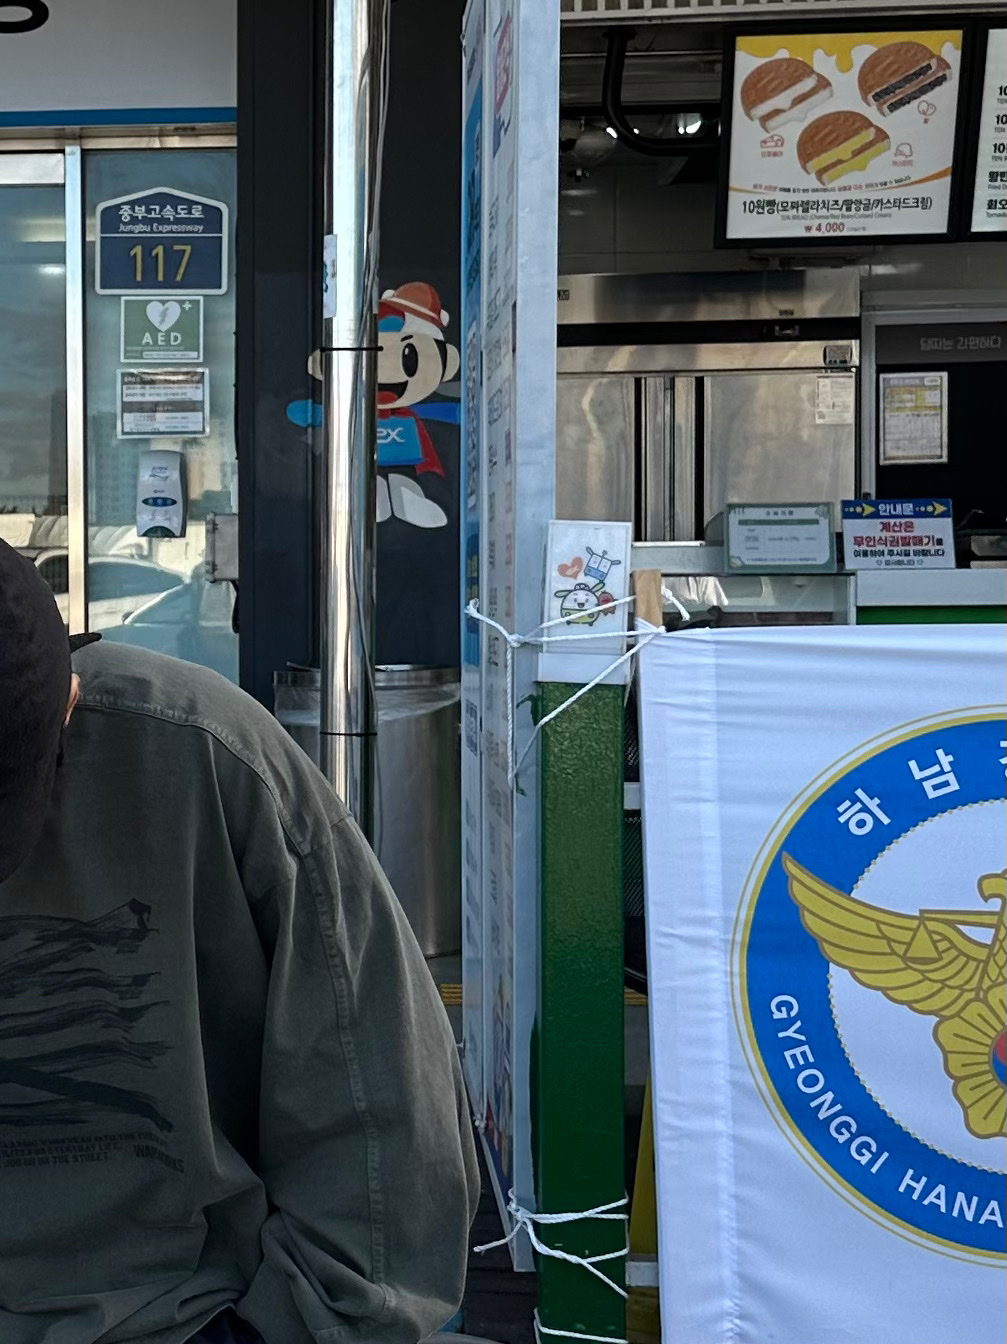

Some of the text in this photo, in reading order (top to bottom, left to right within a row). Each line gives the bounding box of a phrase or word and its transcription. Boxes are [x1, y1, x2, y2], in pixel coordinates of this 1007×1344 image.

[119, 205, 205, 222] 중부고속도로
[119, 223, 204, 234] Jungbu Expressway
[814, 222, 845, 234] 4,000
[129, 245, 192, 282] 117
[142, 332, 182, 346] AED
[878, 503, 914, 516] 안내문
[879, 521, 914, 533] 계산은
[913, 549, 945, 558] 바랍니다
[769, 994, 889, 1175] GYEONGGI
